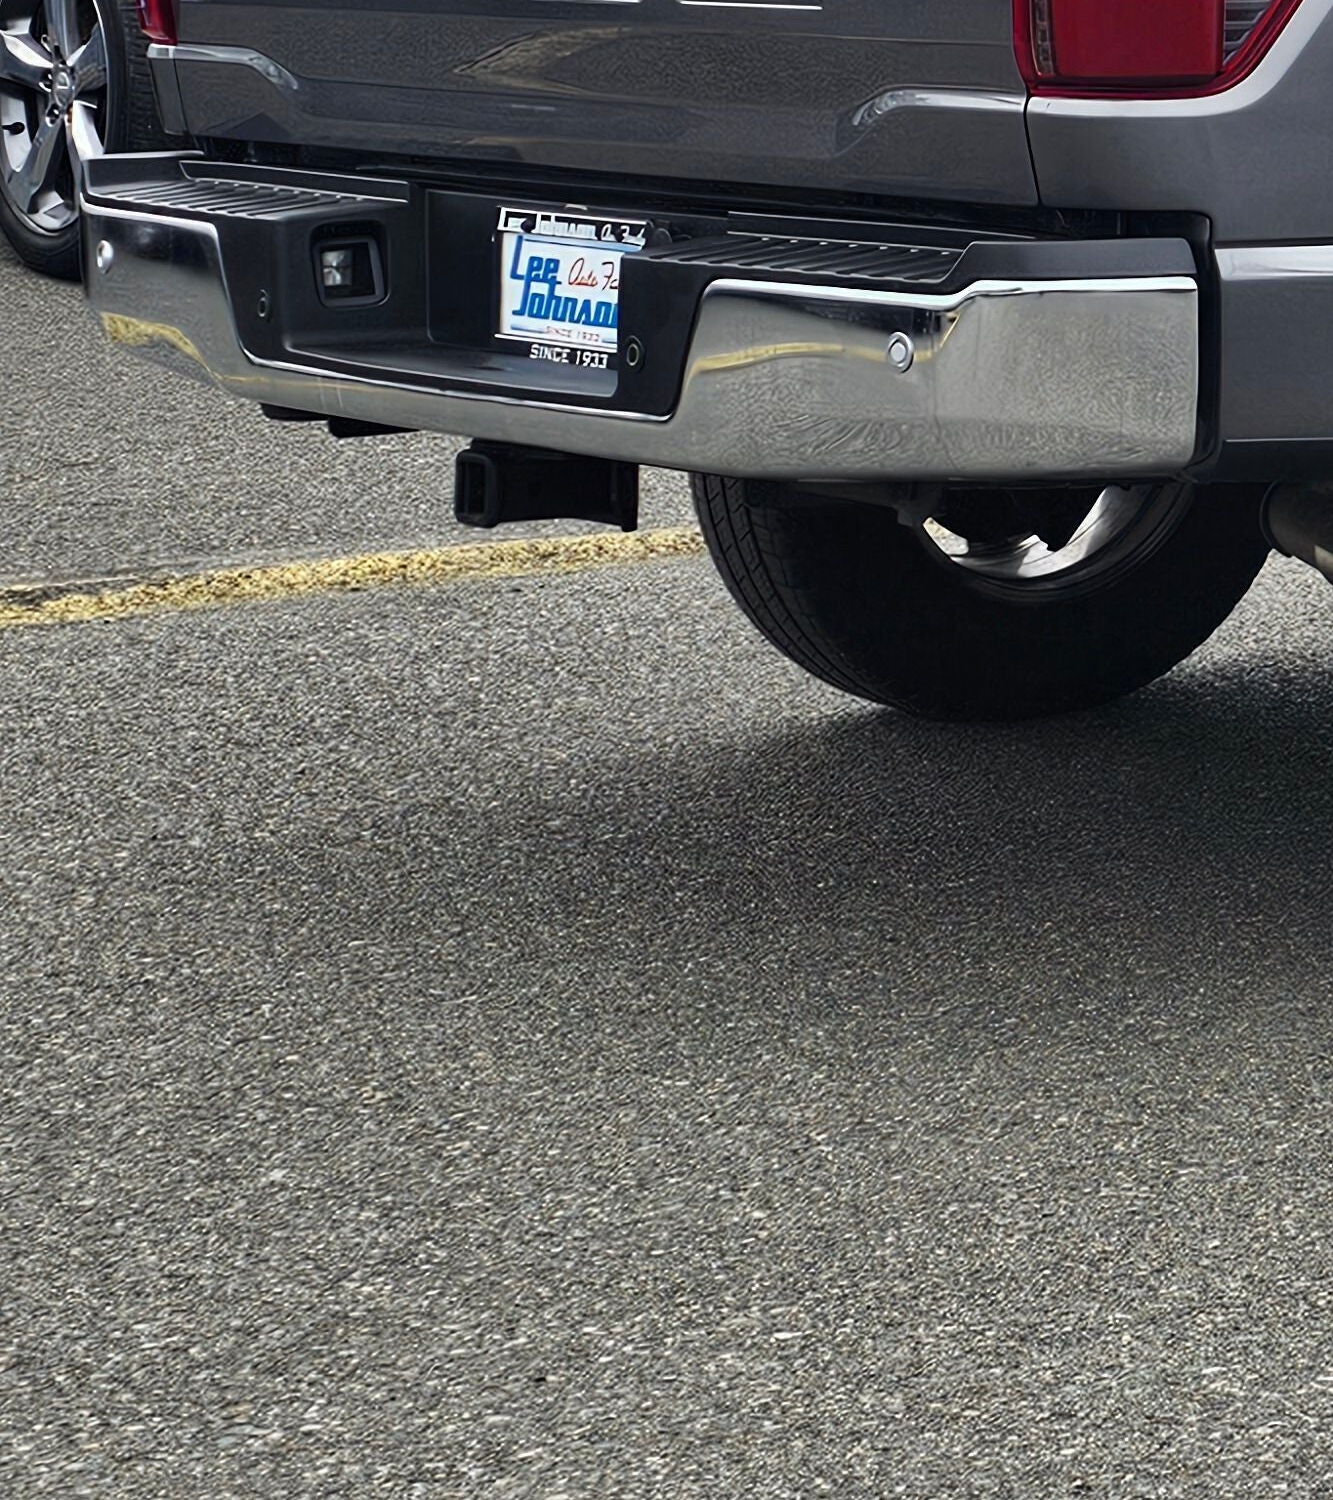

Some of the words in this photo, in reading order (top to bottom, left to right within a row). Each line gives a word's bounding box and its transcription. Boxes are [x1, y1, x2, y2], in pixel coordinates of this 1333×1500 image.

[510, 235, 562, 284] Lee
[529, 343, 571, 364] SINCE
[575, 350, 608, 370] 1933
